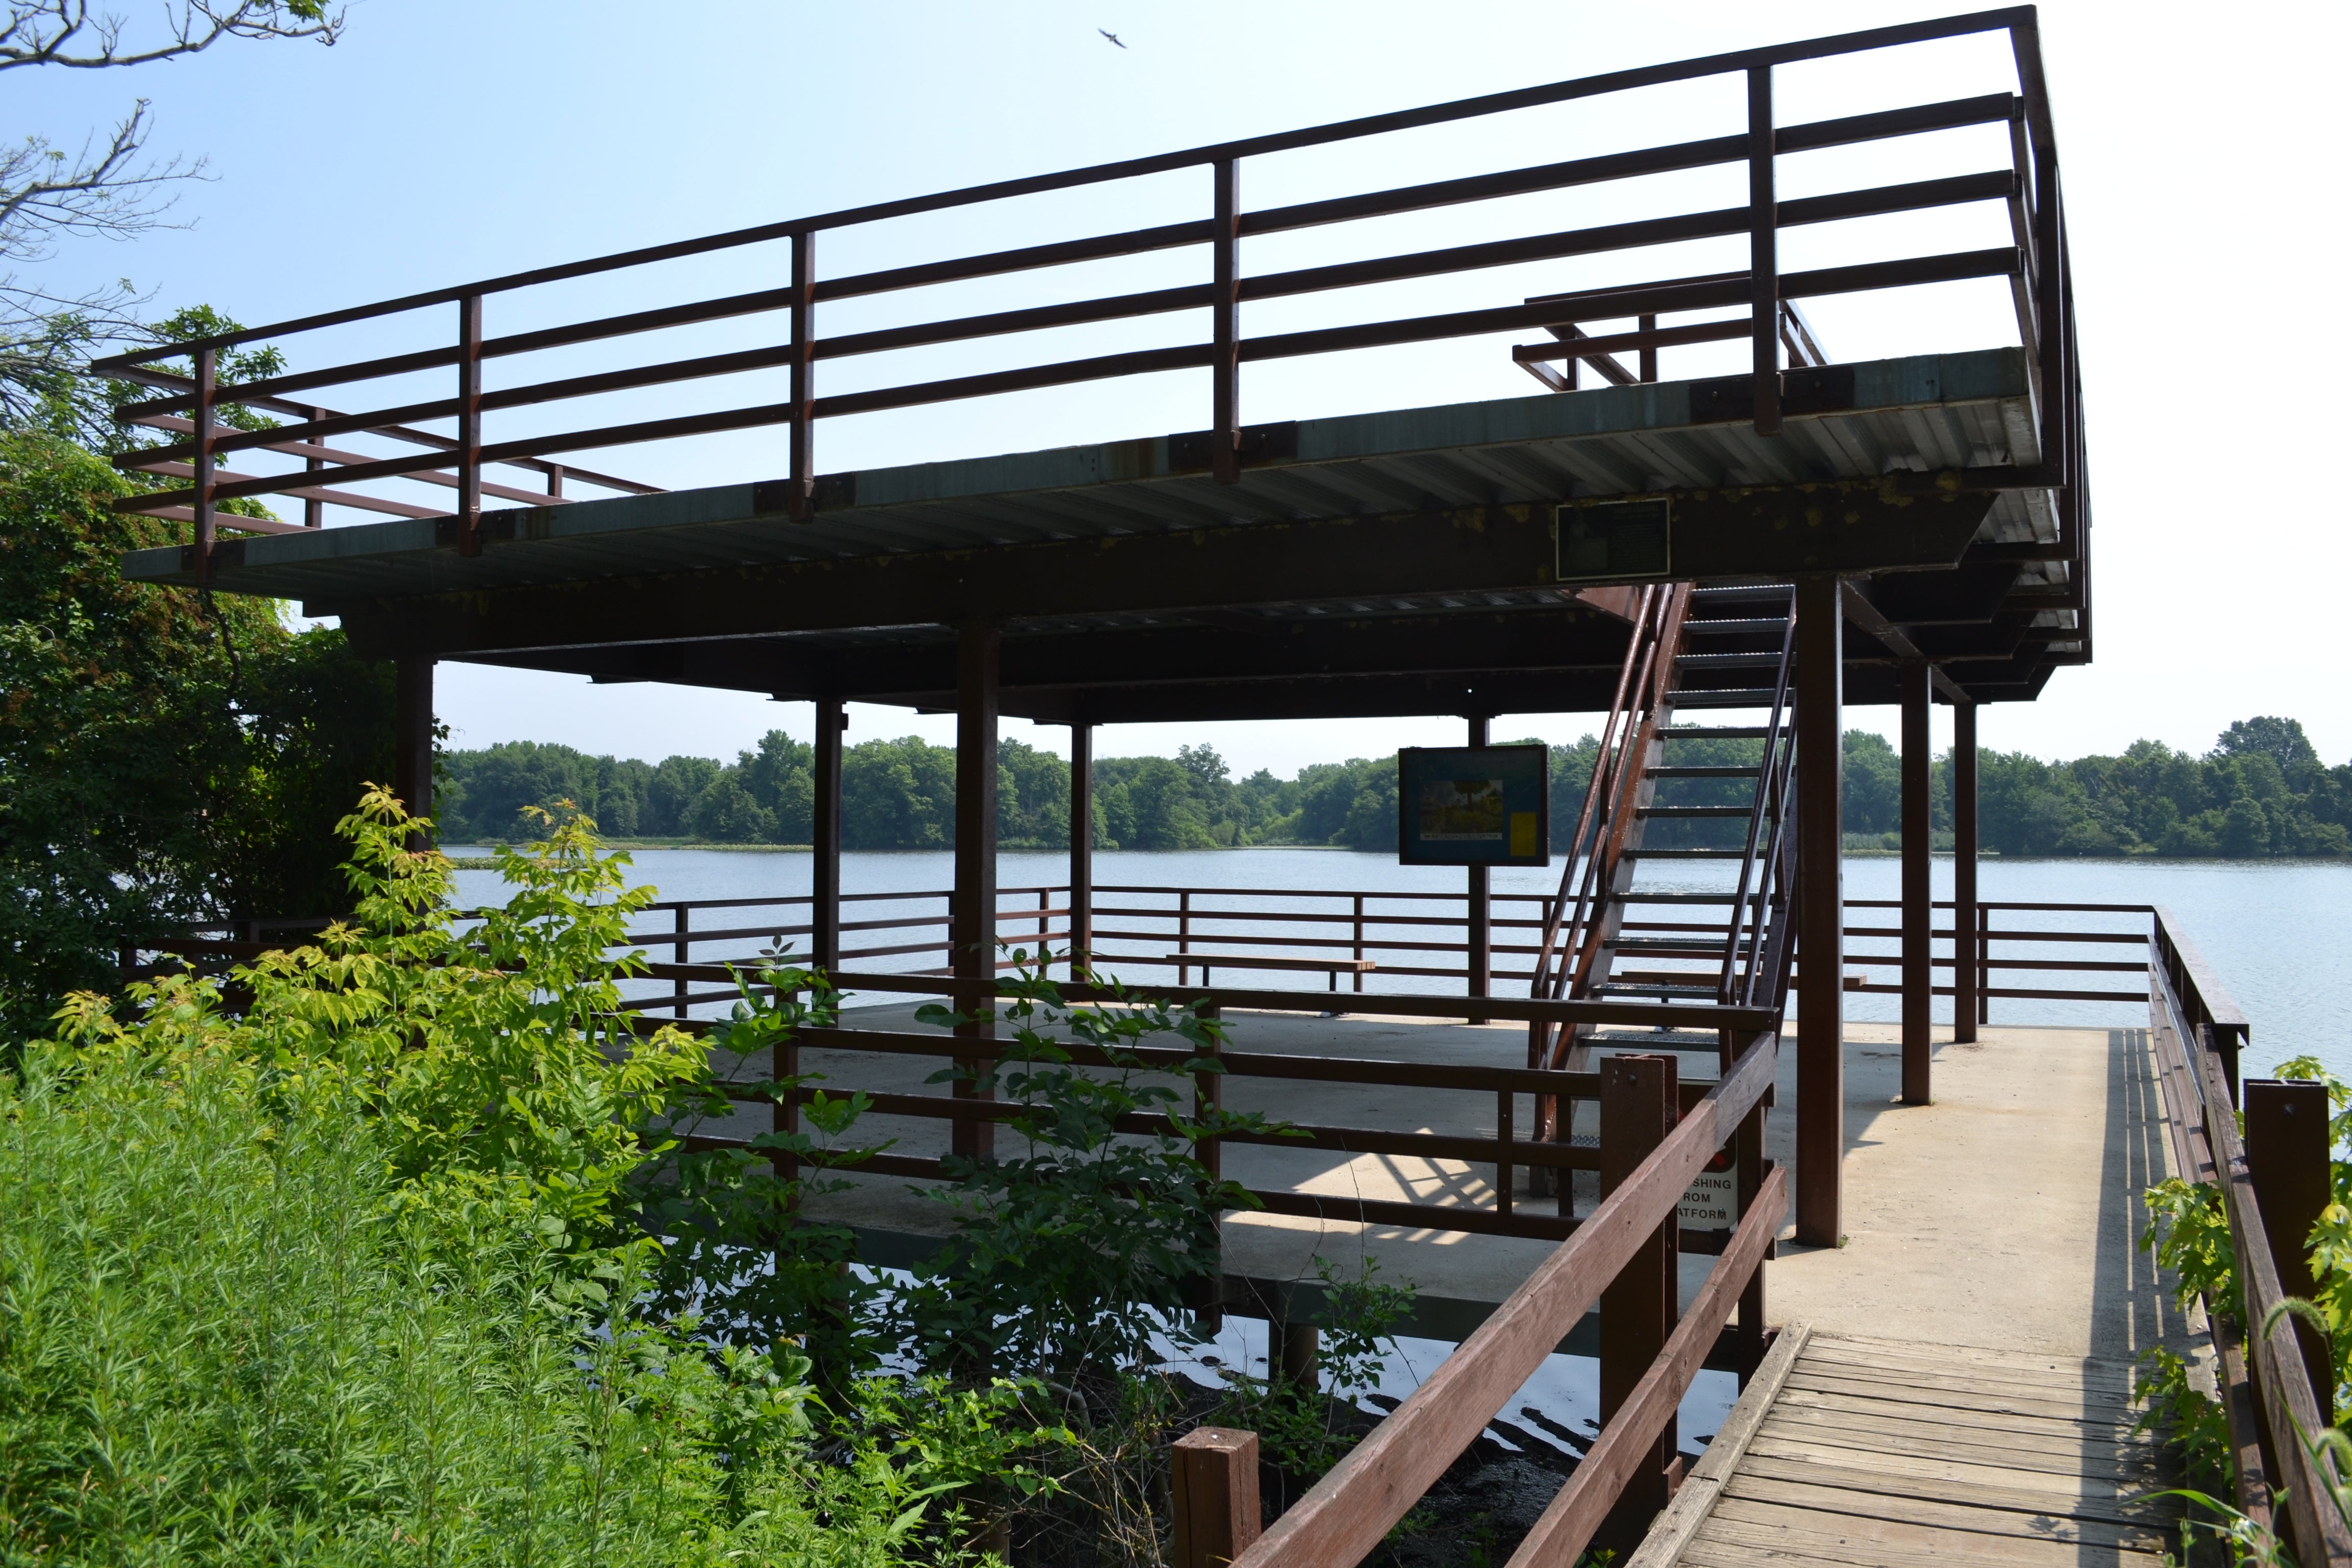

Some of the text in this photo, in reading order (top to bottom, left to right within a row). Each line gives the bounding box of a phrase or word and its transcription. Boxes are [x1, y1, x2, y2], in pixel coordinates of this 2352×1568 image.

[1692, 1178, 1731, 1189] SHING
[1683, 1192, 1710, 1203] ROM
[1678, 1208, 1726, 1220] ATFORM
